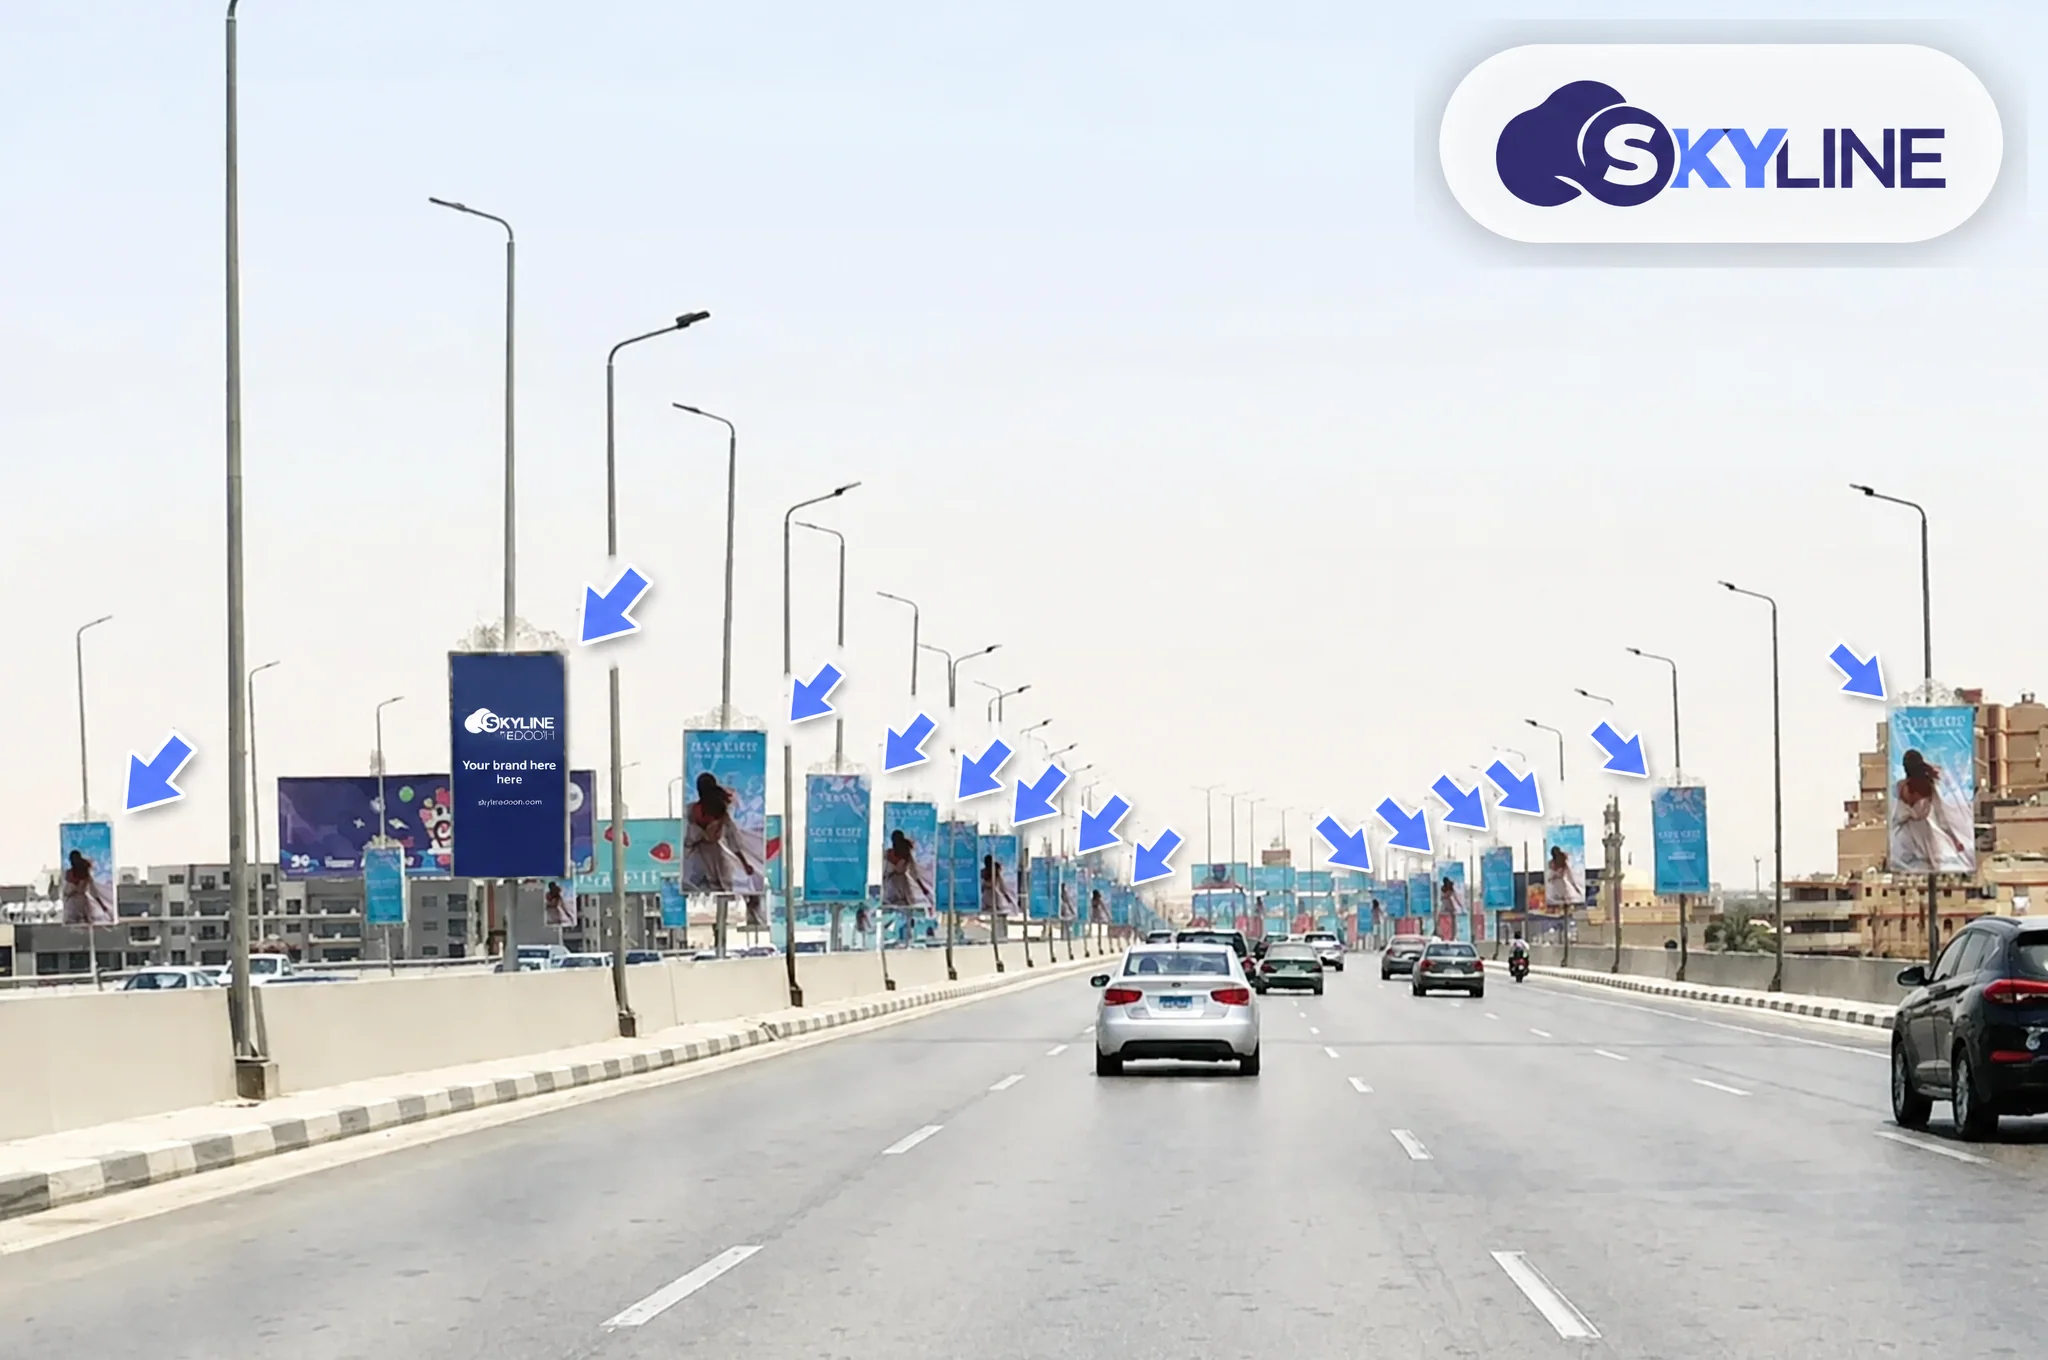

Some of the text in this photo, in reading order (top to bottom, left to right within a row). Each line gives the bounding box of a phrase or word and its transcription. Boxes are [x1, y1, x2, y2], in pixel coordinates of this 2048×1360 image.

[486, 716, 555, 730] SKYLINE
[462, 760, 556, 770] Your brand here
[496, 774, 523, 784] here
